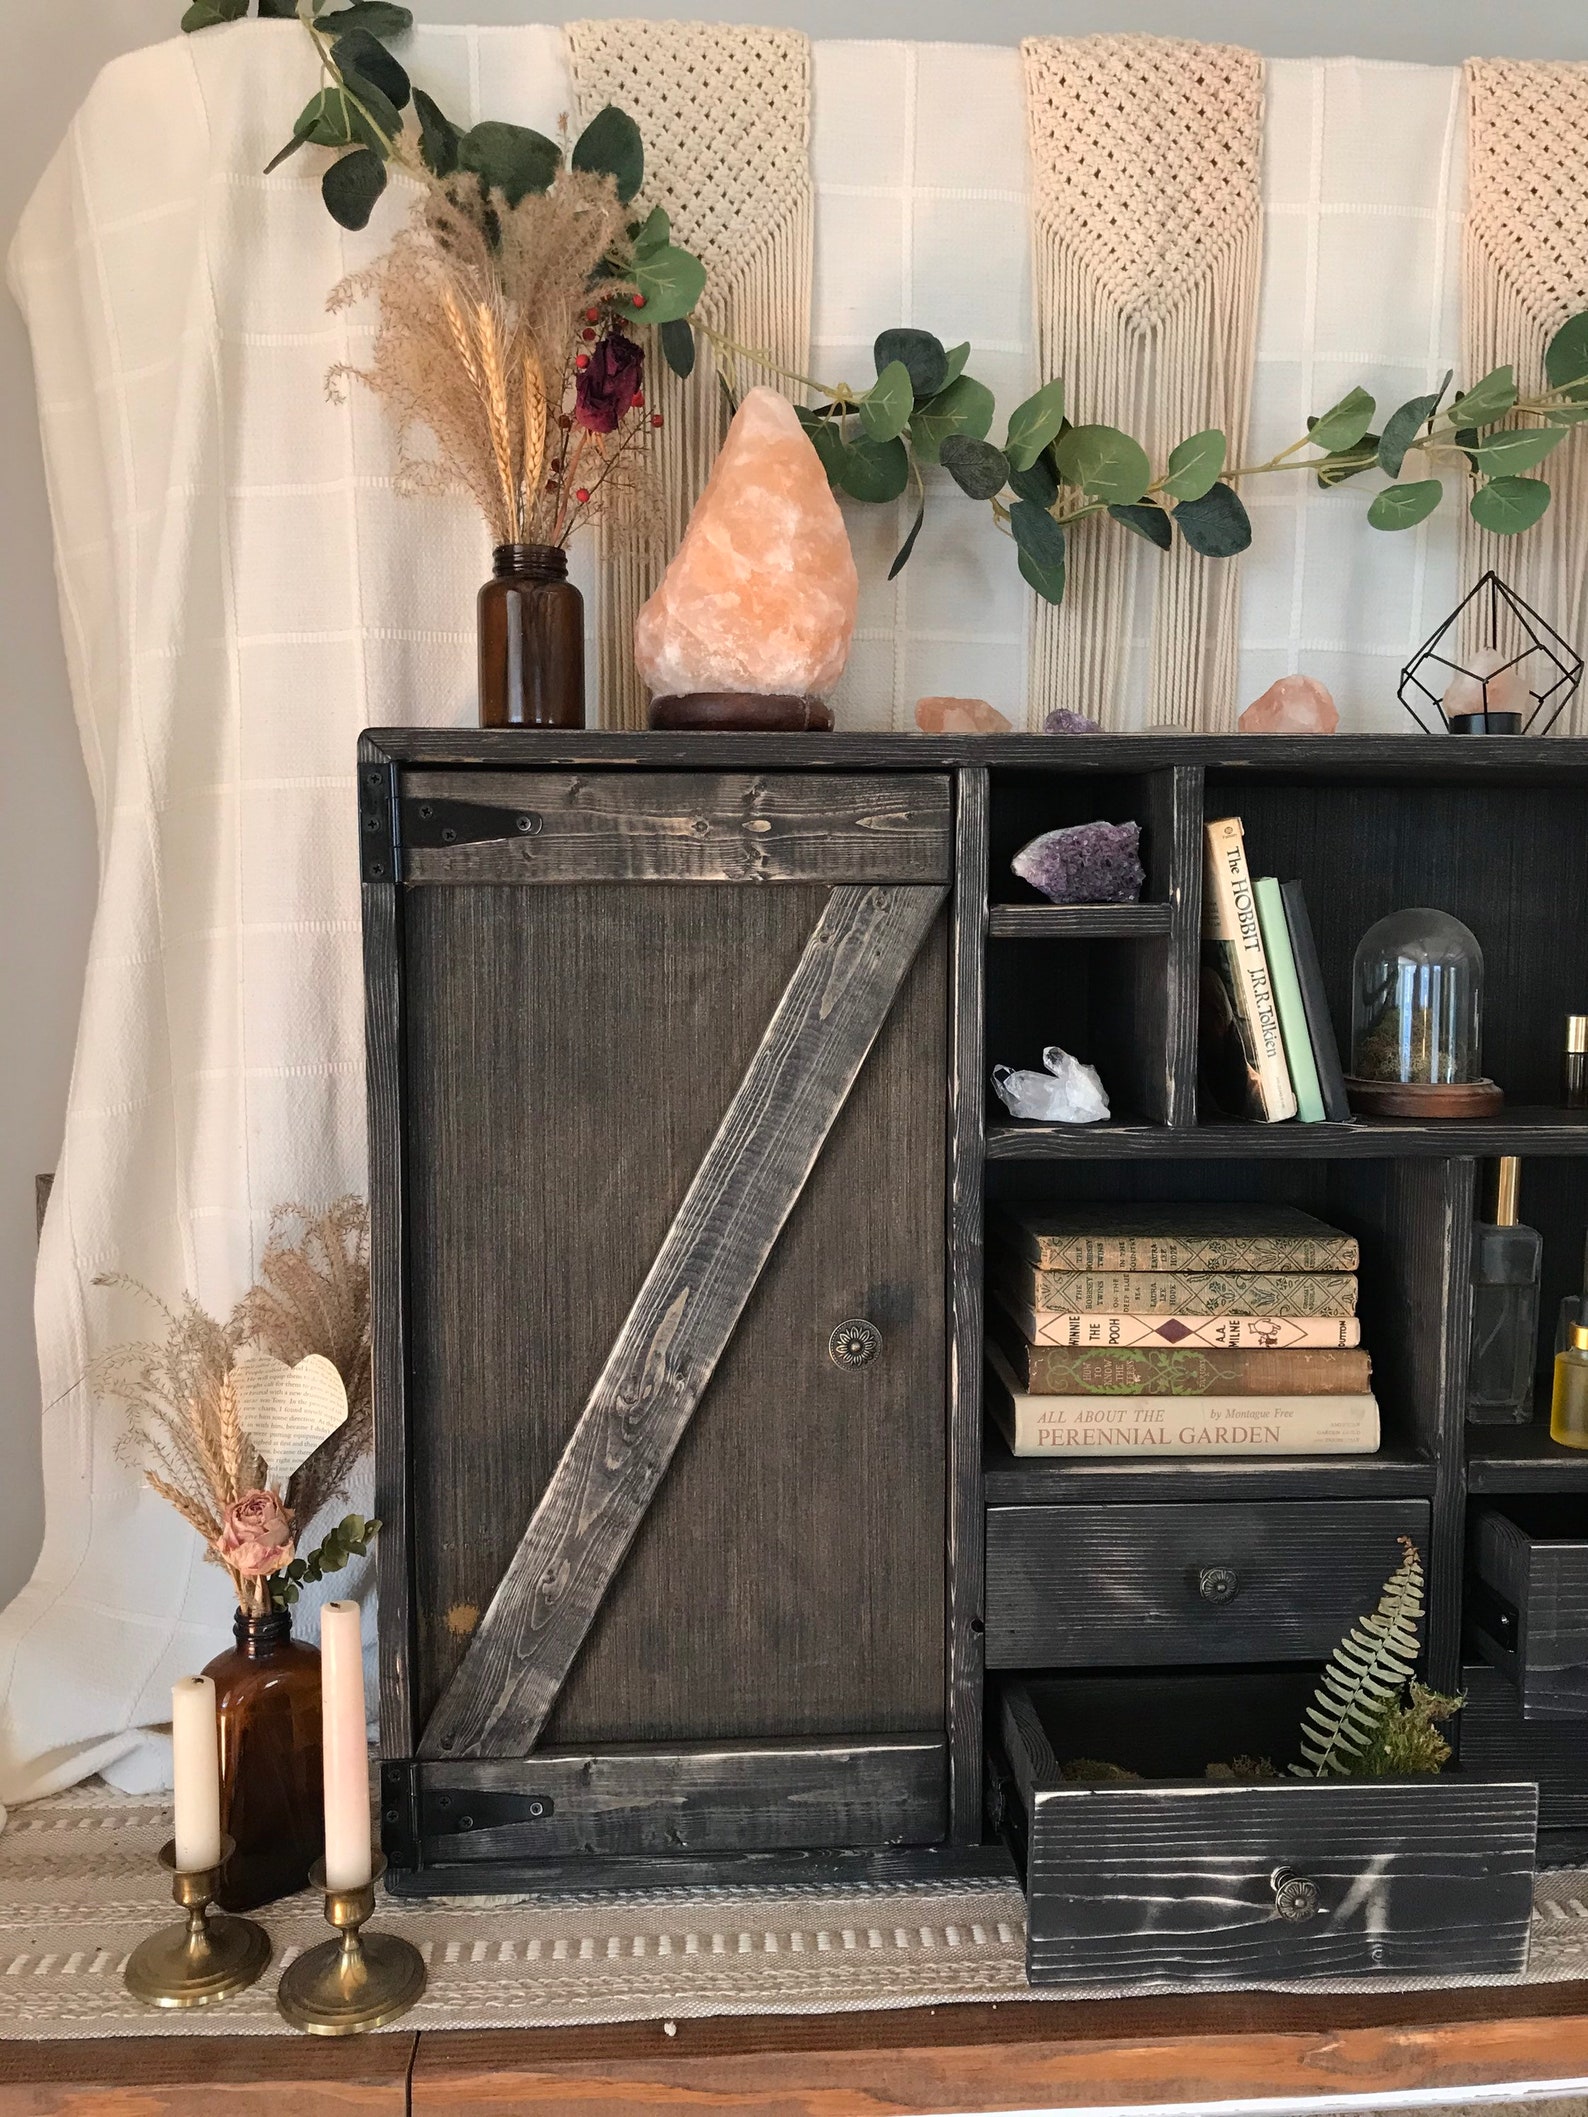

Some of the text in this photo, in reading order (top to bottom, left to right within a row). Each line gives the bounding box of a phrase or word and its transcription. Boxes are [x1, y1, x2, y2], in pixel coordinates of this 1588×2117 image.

[1227, 845, 1242, 875] The
[1231, 878, 1261, 952] HOBBIT
[1069, 1315, 1080, 1346] WINNIE
[1089, 1323, 1101, 1341] THE
[1109, 1318, 1120, 1344] POOH
[1229, 1320, 1240, 1347] MILNE
[1338, 1320, 1347, 1347] DUTTON
[1083, 1362, 1091, 1380] HOW
[1094, 1366, 1101, 1378] TO
[1103, 1358, 1112, 1386] KNOW
[1116, 1364, 1124, 1381] THE
[1037, 1409, 1165, 1424] ALL ABOUT THE
[1210, 1408, 1294, 1420] by Montague Free
[1037, 1426, 1281, 1446] PERENNIAL GARDEN
